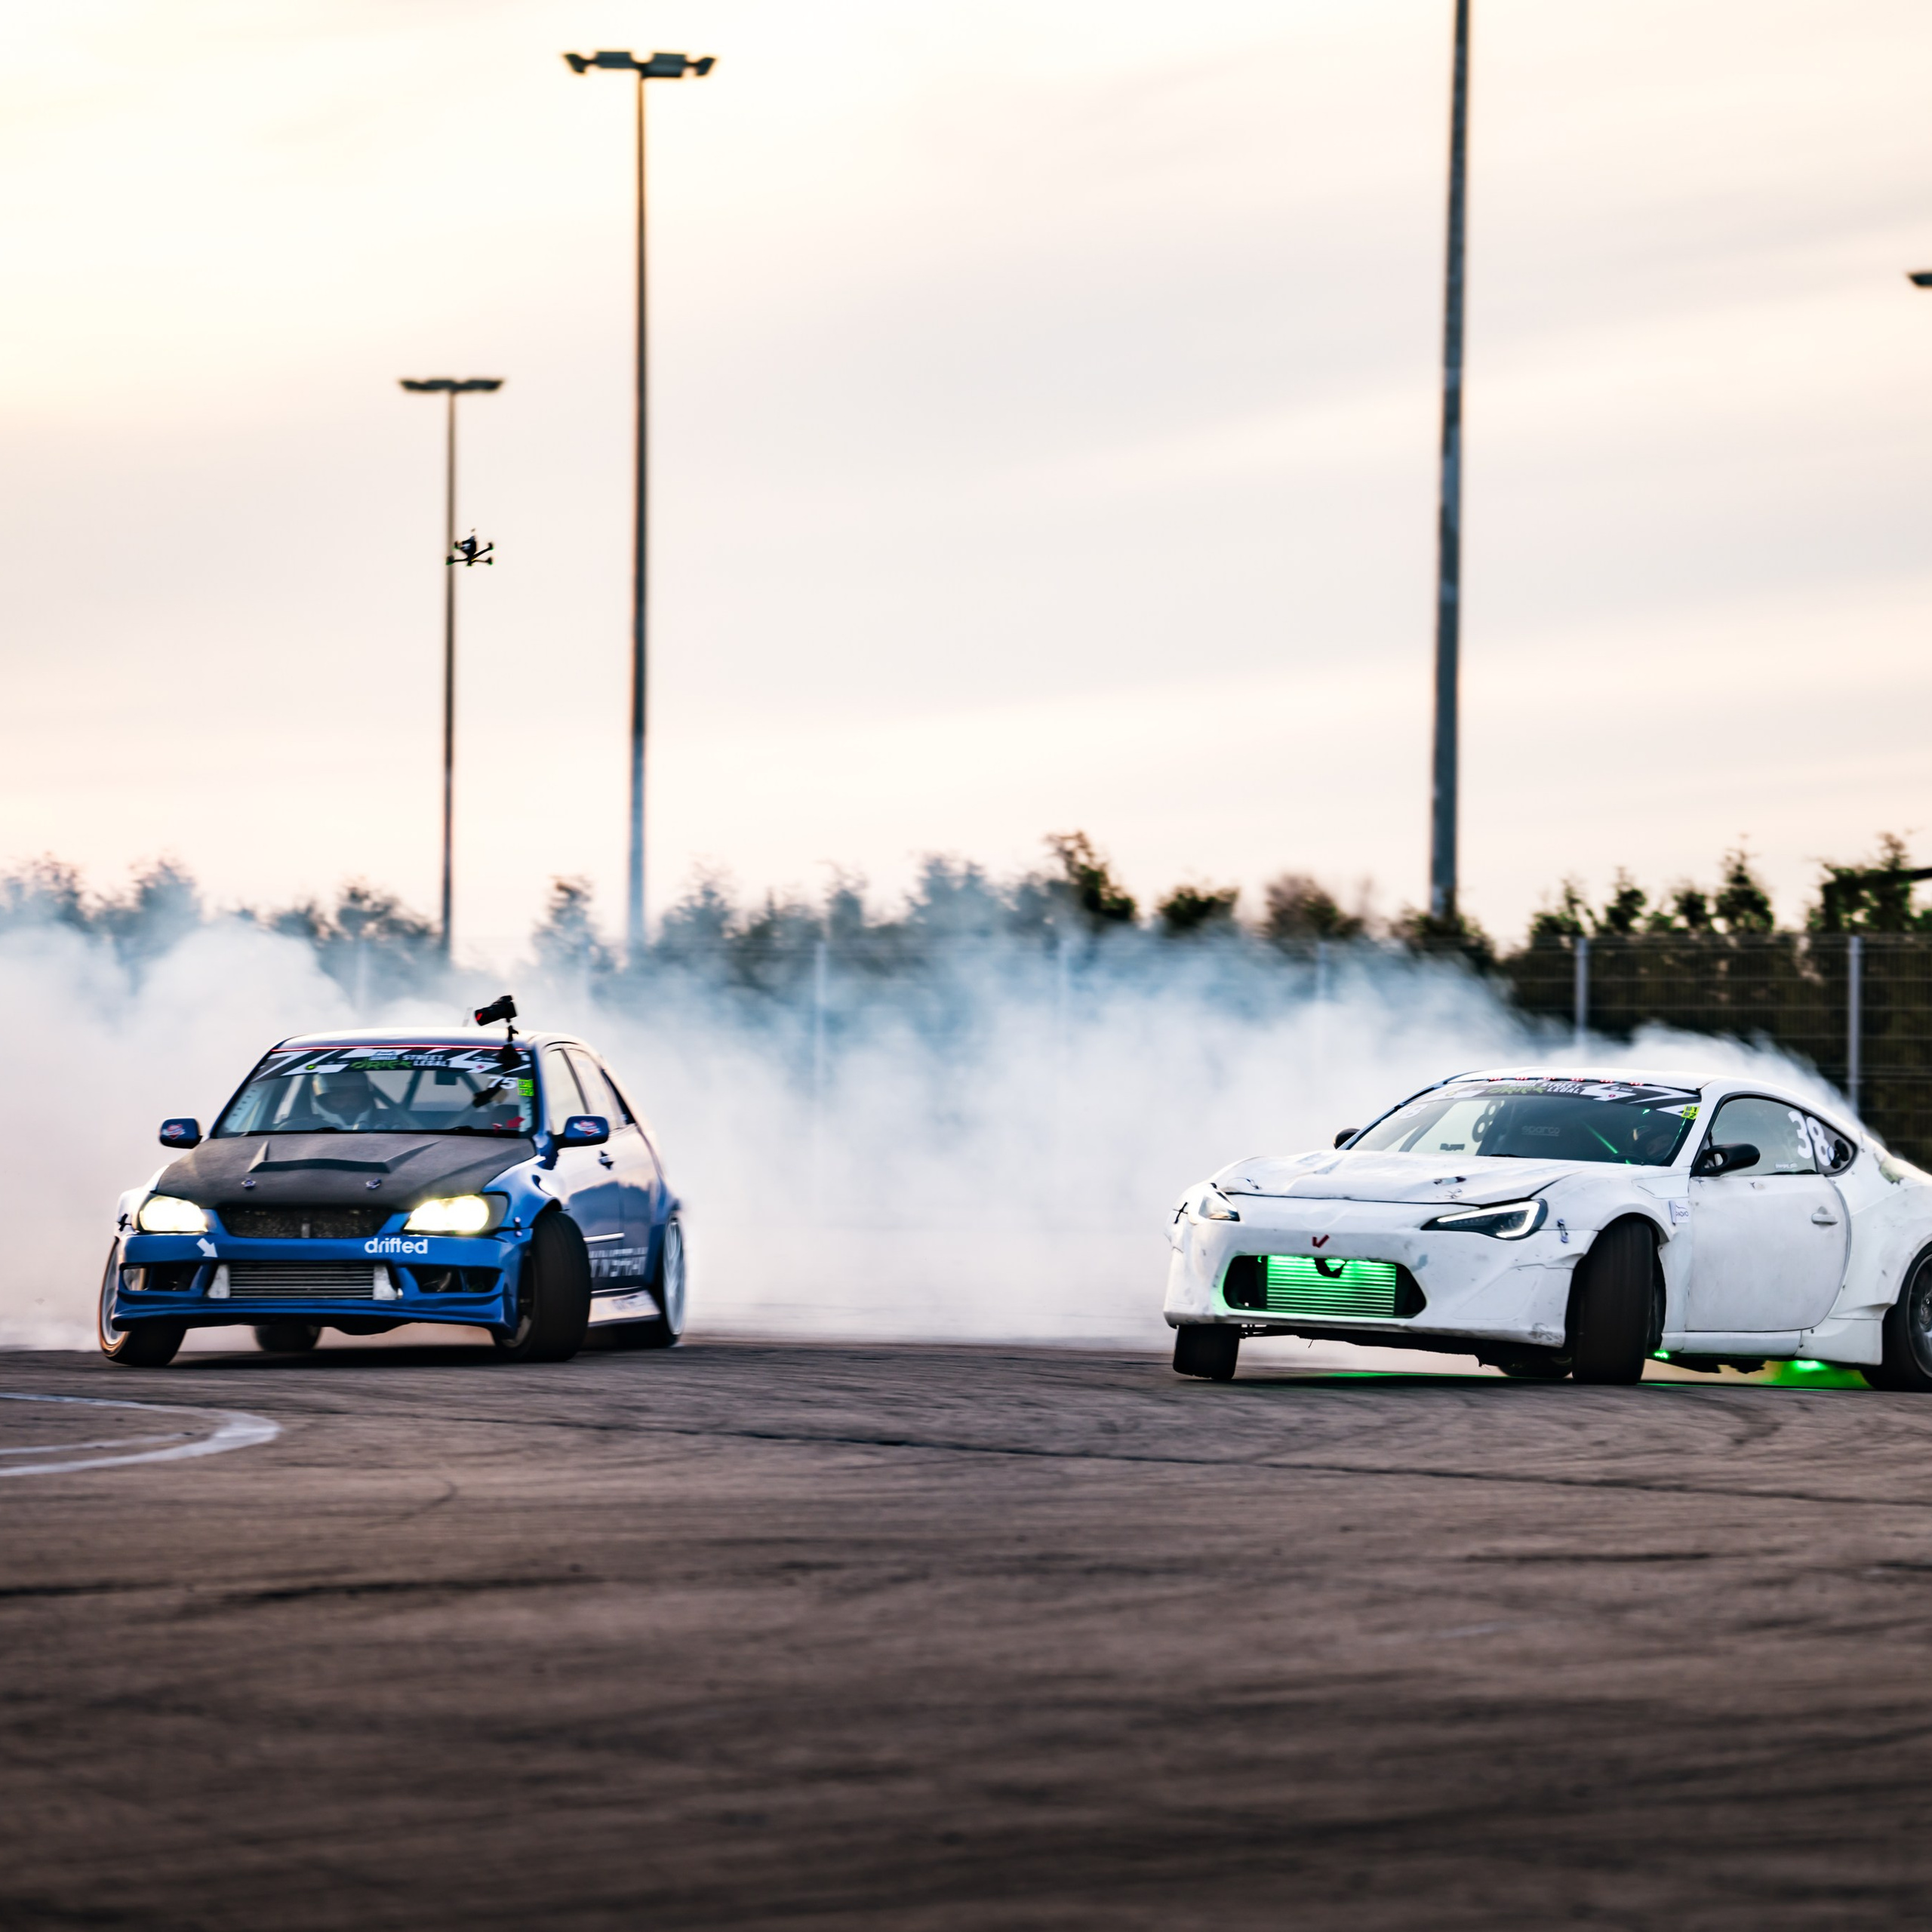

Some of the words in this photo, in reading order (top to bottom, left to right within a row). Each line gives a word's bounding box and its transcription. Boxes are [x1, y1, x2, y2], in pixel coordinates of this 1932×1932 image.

[488, 1076, 519, 1090] 75
[1521, 1125, 1561, 1135] sparco
[1788, 1111, 1832, 1167] 38
[364, 1237, 429, 1254] drifted
